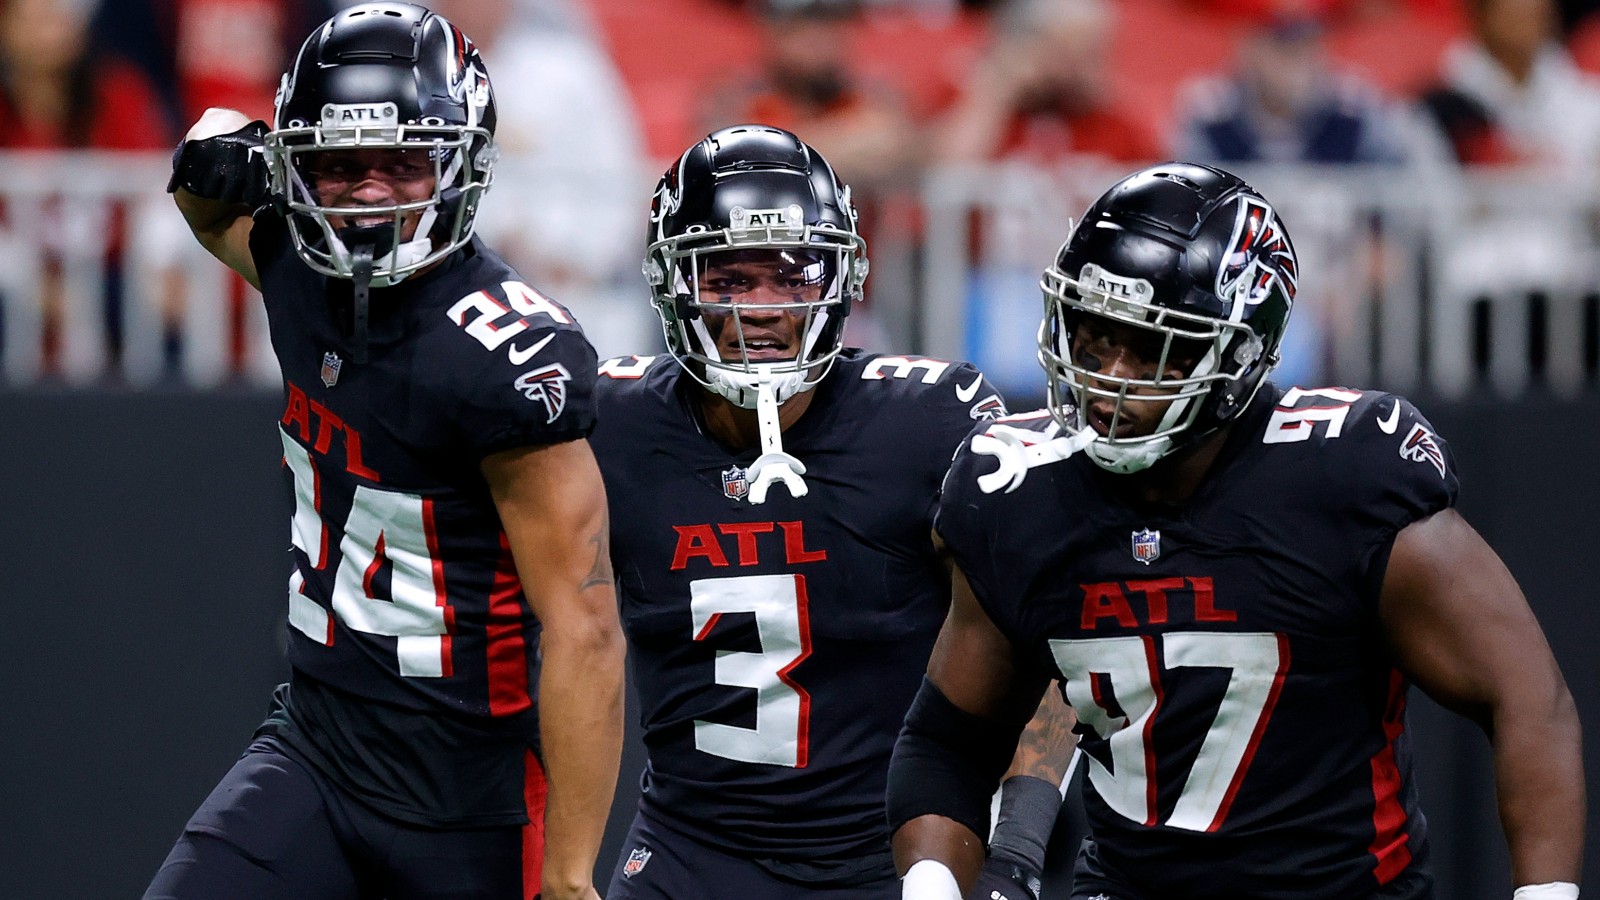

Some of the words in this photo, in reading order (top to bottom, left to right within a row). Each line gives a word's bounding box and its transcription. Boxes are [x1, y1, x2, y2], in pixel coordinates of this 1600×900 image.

[342, 108, 380, 121] ATL
[750, 213, 786, 225] ATL
[1097, 278, 1131, 297] ATL
[446, 281, 572, 351] 24
[861, 356, 950, 385] 3
[282, 380, 380, 482] ATL
[1263, 385, 1362, 444] 97
[670, 521, 827, 570] ATL
[1080, 576, 1238, 630] ATL
[690, 573, 812, 769] 3
[1048, 631, 1291, 833] 97
